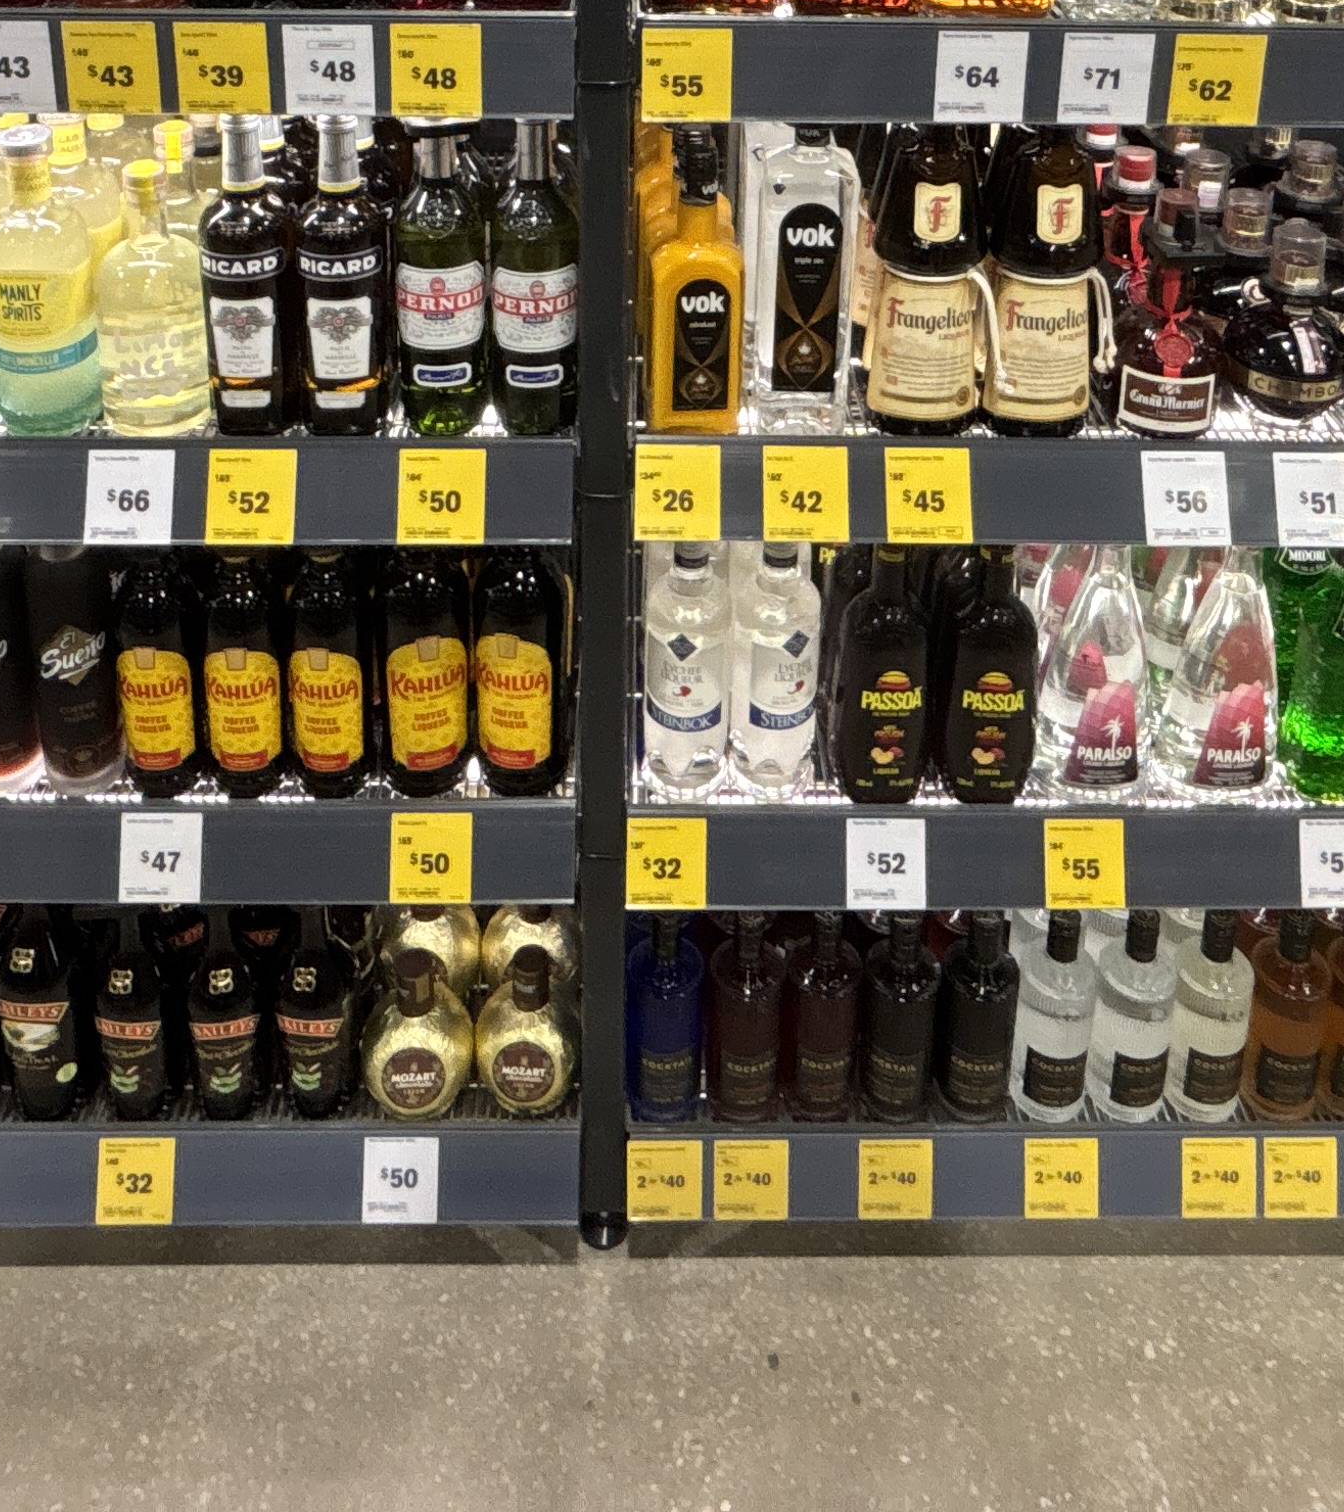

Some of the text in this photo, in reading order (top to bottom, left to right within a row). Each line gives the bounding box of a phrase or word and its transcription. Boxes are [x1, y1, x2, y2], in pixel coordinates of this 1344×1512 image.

[88, 65, 133, 87] $43
[199, 65, 243, 87] $39
[310, 60, 355, 82] $48
[955, 65, 999, 87] $64
[1084, 68, 1120, 89] $71
[661, 74, 703, 97] $55
[1189, 79, 1232, 101] $62
[787, 224, 835, 248] vok
[201, 254, 278, 276] RICARD
[299, 255, 377, 275] RICARD
[1, 301, 44, 322] SPIRITS
[682, 291, 725, 314] vok
[1129, 390, 1205, 409] Grand Marnier
[107, 489, 149, 512] $66
[229, 491, 269, 514] $52
[419, 490, 461, 513] $50
[653, 489, 693, 512] $26
[780, 490, 822, 513] $42
[1166, 490, 1207, 513] $56
[1300, 491, 1336, 514] $51
[1288, 547, 1327, 562] MIDORI
[1077, 745, 1133, 762] PARAISO
[1207, 745, 1262, 763] PARAISO
[141, 851, 180, 872] $47
[643, 858, 681, 879] $32
[391, 1072, 436, 1083] MOZART
[502, 1067, 546, 1078] MOZART
